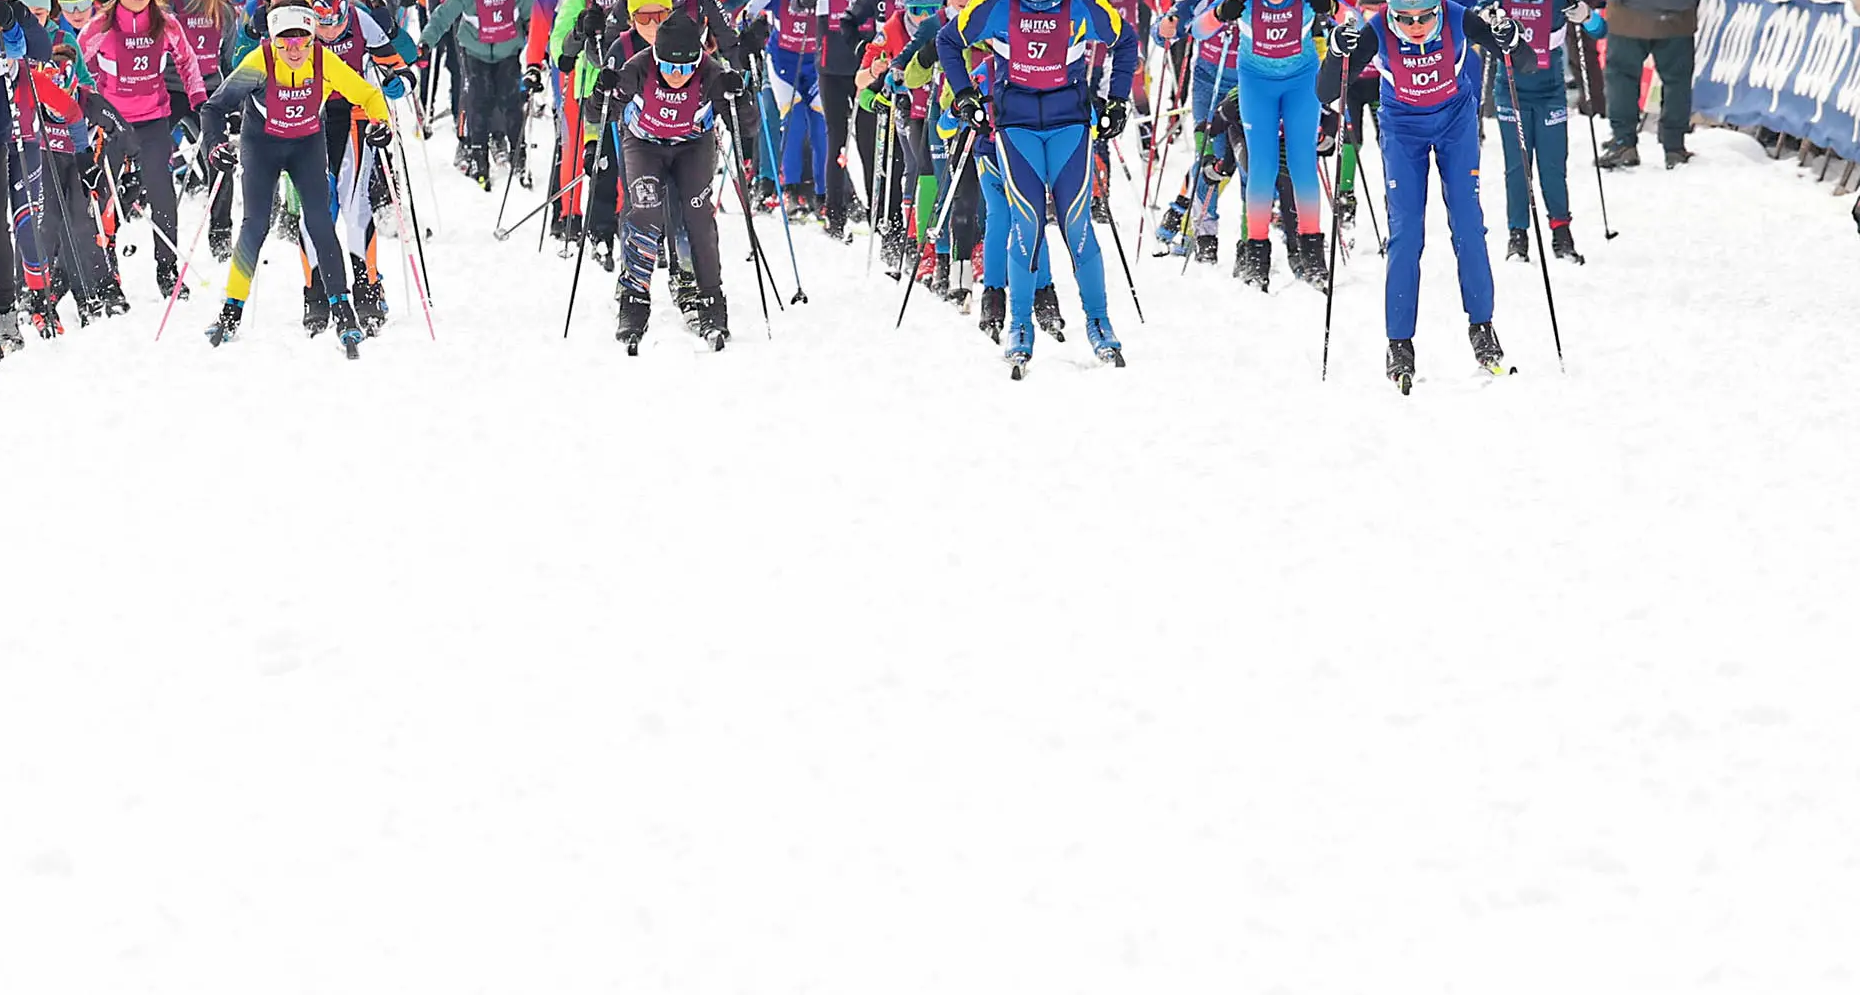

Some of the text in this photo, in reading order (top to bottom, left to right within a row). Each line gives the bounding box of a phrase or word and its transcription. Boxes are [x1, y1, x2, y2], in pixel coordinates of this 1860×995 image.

[792, 22, 807, 34] 33
[1032, 20, 1056, 30] ITAS
[1266, 28, 1288, 40] 107
[136, 37, 154, 45] ITAS
[1028, 42, 1048, 59] 57
[133, 56, 148, 70] 23
[1418, 53, 1442, 65] ITAS
[1412, 71, 1439, 86] 104
[291, 88, 312, 97] ITAS
[666, 92, 687, 102] ITAS
[285, 105, 304, 118] 52
[49, 139, 64, 149] 66
